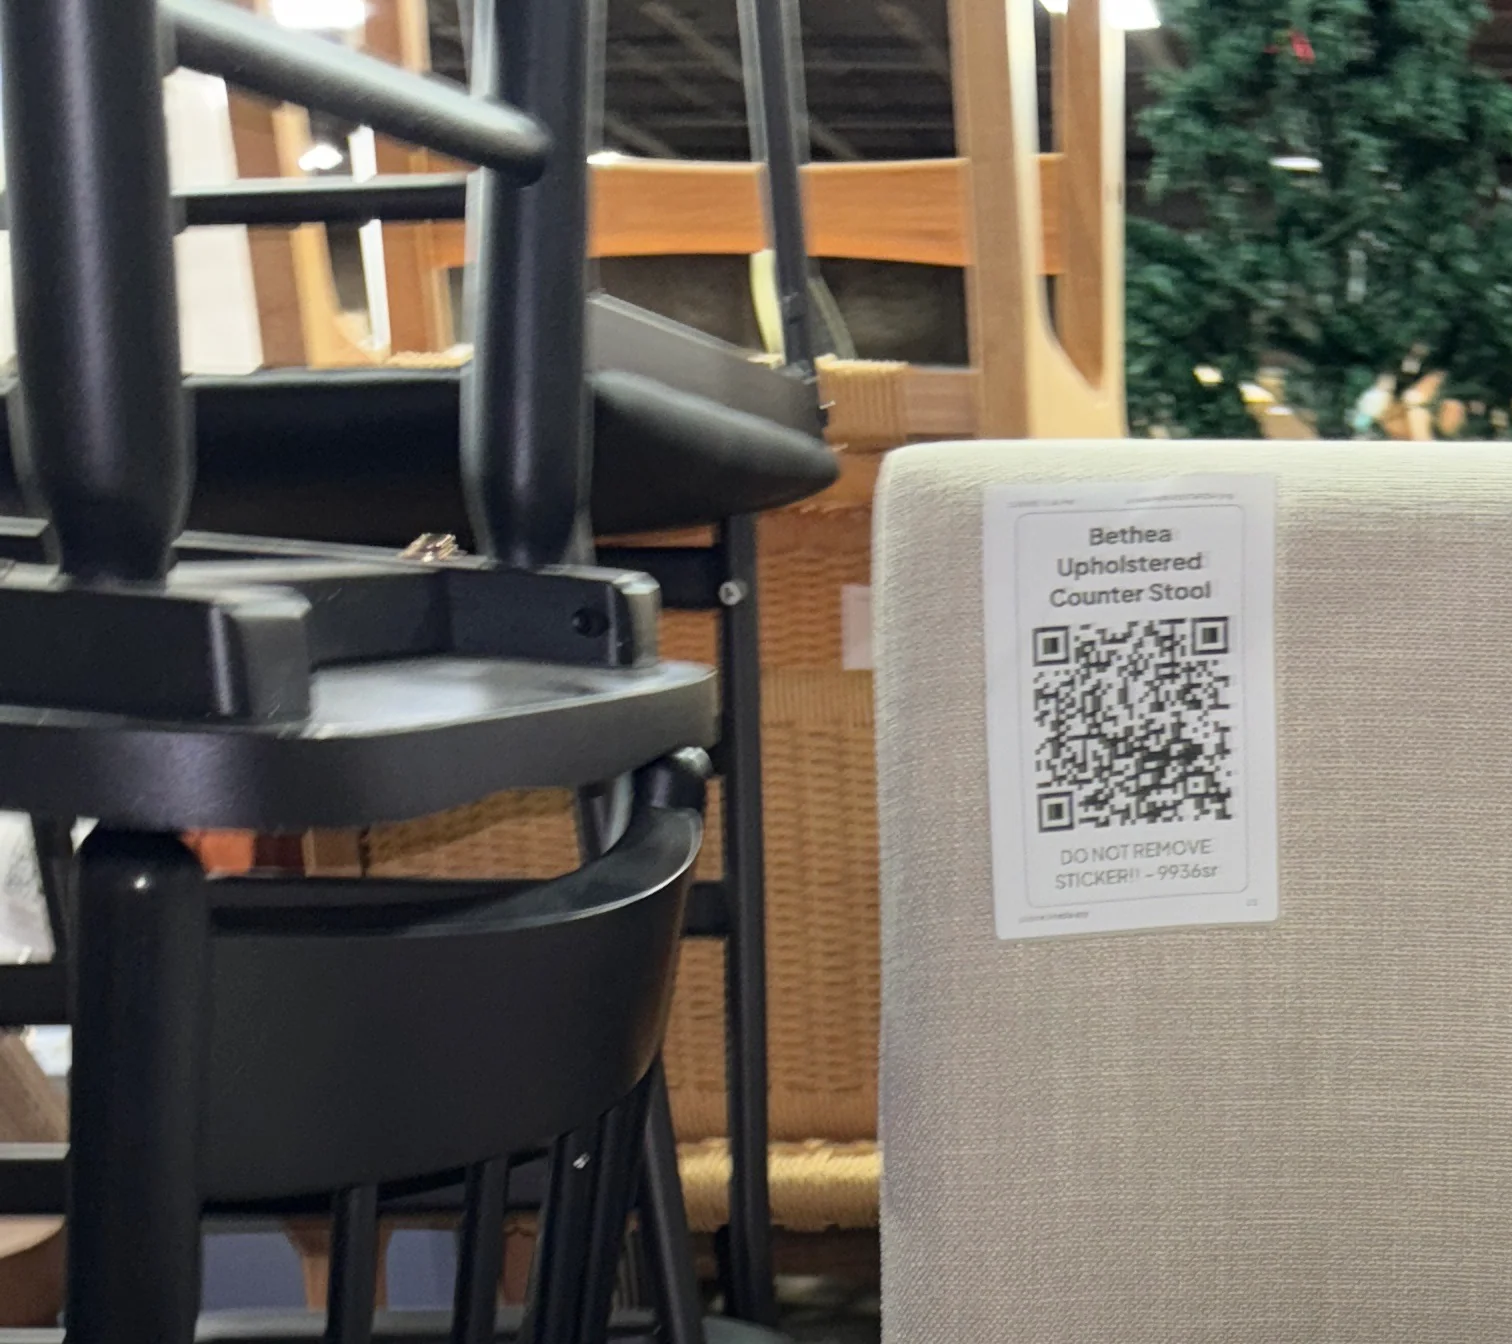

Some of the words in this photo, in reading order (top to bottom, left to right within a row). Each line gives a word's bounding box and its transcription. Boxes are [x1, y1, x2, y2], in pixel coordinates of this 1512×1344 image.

[1088, 525, 1173, 547] Bethea
[1056, 551, 1204, 581] Upholstered
[1049, 586, 1145, 608] Counter
[1149, 580, 1213, 602] Stool
[1060, 847, 1089, 866] DO
[1091, 843, 1128, 864] NOT
[1133, 838, 1213, 859] REMOVE
